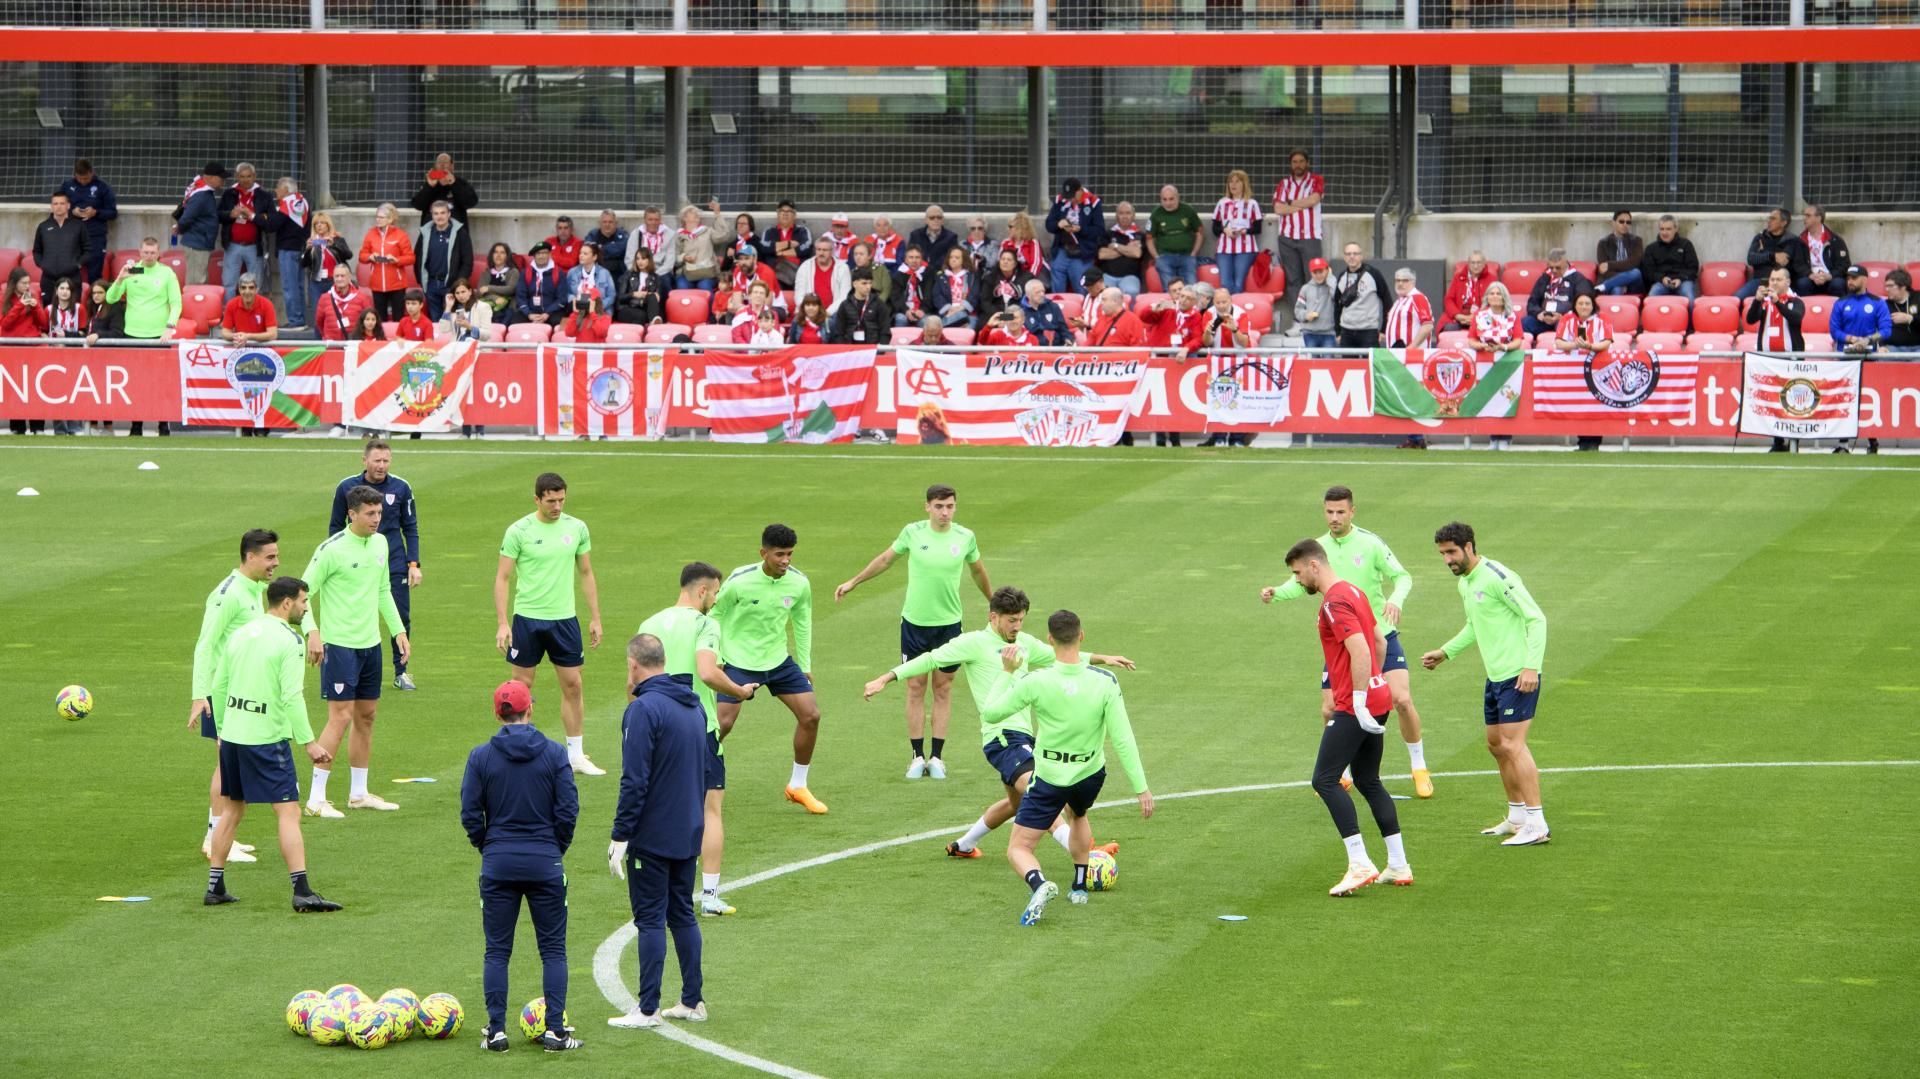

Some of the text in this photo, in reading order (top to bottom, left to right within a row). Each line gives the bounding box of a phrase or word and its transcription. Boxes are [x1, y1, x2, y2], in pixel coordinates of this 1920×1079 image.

[984, 355, 1138, 377] Peña Gainza
[1793, 363, 1818, 374] AUPA
[0, 364, 132, 405] NCAR
[483, 381, 522, 409] 0,0
[1030, 394, 1059, 403] DESDE
[1774, 421, 1820, 433] ATHLETIC
[227, 695, 267, 714] DIGI
